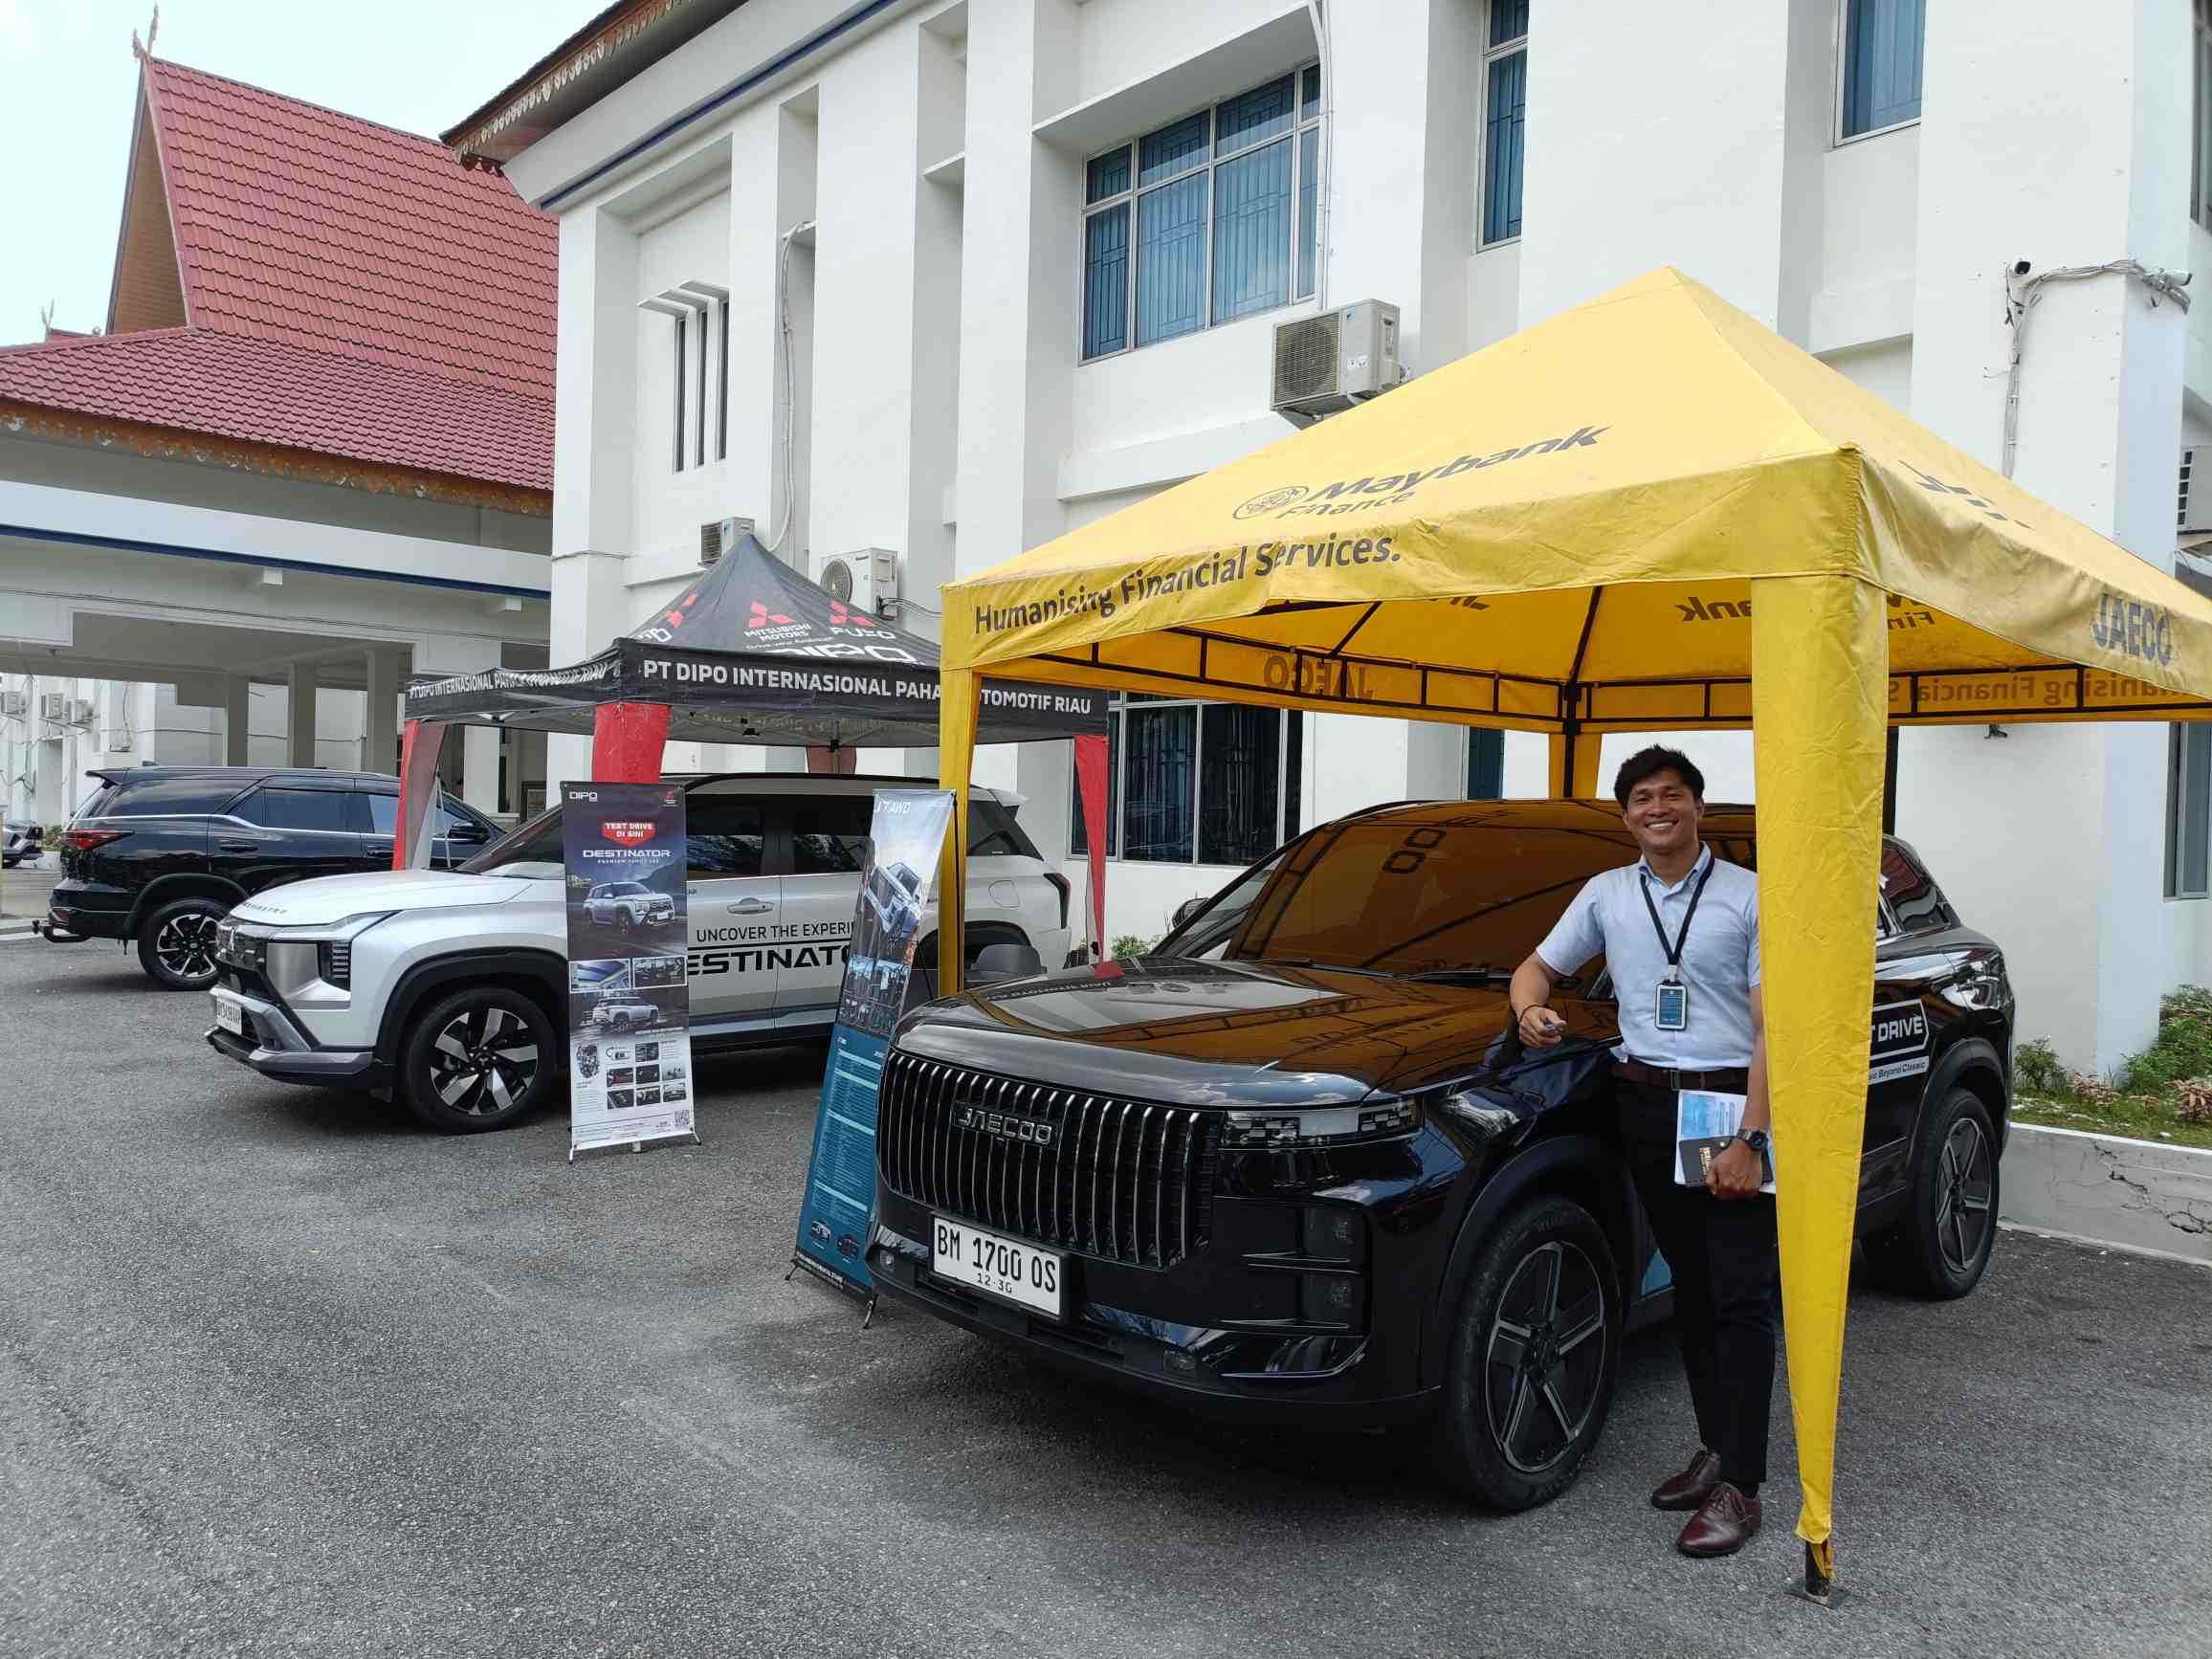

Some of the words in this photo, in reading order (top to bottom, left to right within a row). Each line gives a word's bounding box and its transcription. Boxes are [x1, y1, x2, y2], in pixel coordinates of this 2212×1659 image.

[1308, 425, 1614, 496] Maybank
[1276, 490, 1416, 520] Finance
[973, 586, 1116, 635] Humanising
[1121, 546, 1249, 605] Financial
[1254, 532, 1401, 577] Services.
[743, 623, 812, 637] MITSUBISHI
[760, 630, 809, 642] MOTORS
[643, 659, 672, 680] PT
[676, 662, 727, 684] DIPO
[733, 667, 891, 697] INTERNASIONAL
[979, 689, 1051, 710] TOMOTIF
[1055, 696, 1091, 715] RIAU
[569, 791, 598, 803] DIPO
[605, 822, 628, 830] TEST
[630, 822, 654, 830] DRIVE
[583, 849, 672, 858] DESTINATOR
[697, 926, 766, 942] UNCOVER
[770, 923, 798, 939] THE
[1877, 1015, 1923, 1042] DRIVE
[958, 1107, 1052, 1145] JAECOO
[938, 1225, 961, 1262] BM
[972, 1237, 1023, 1281] 1700
[1031, 1255, 1056, 1293] OS
